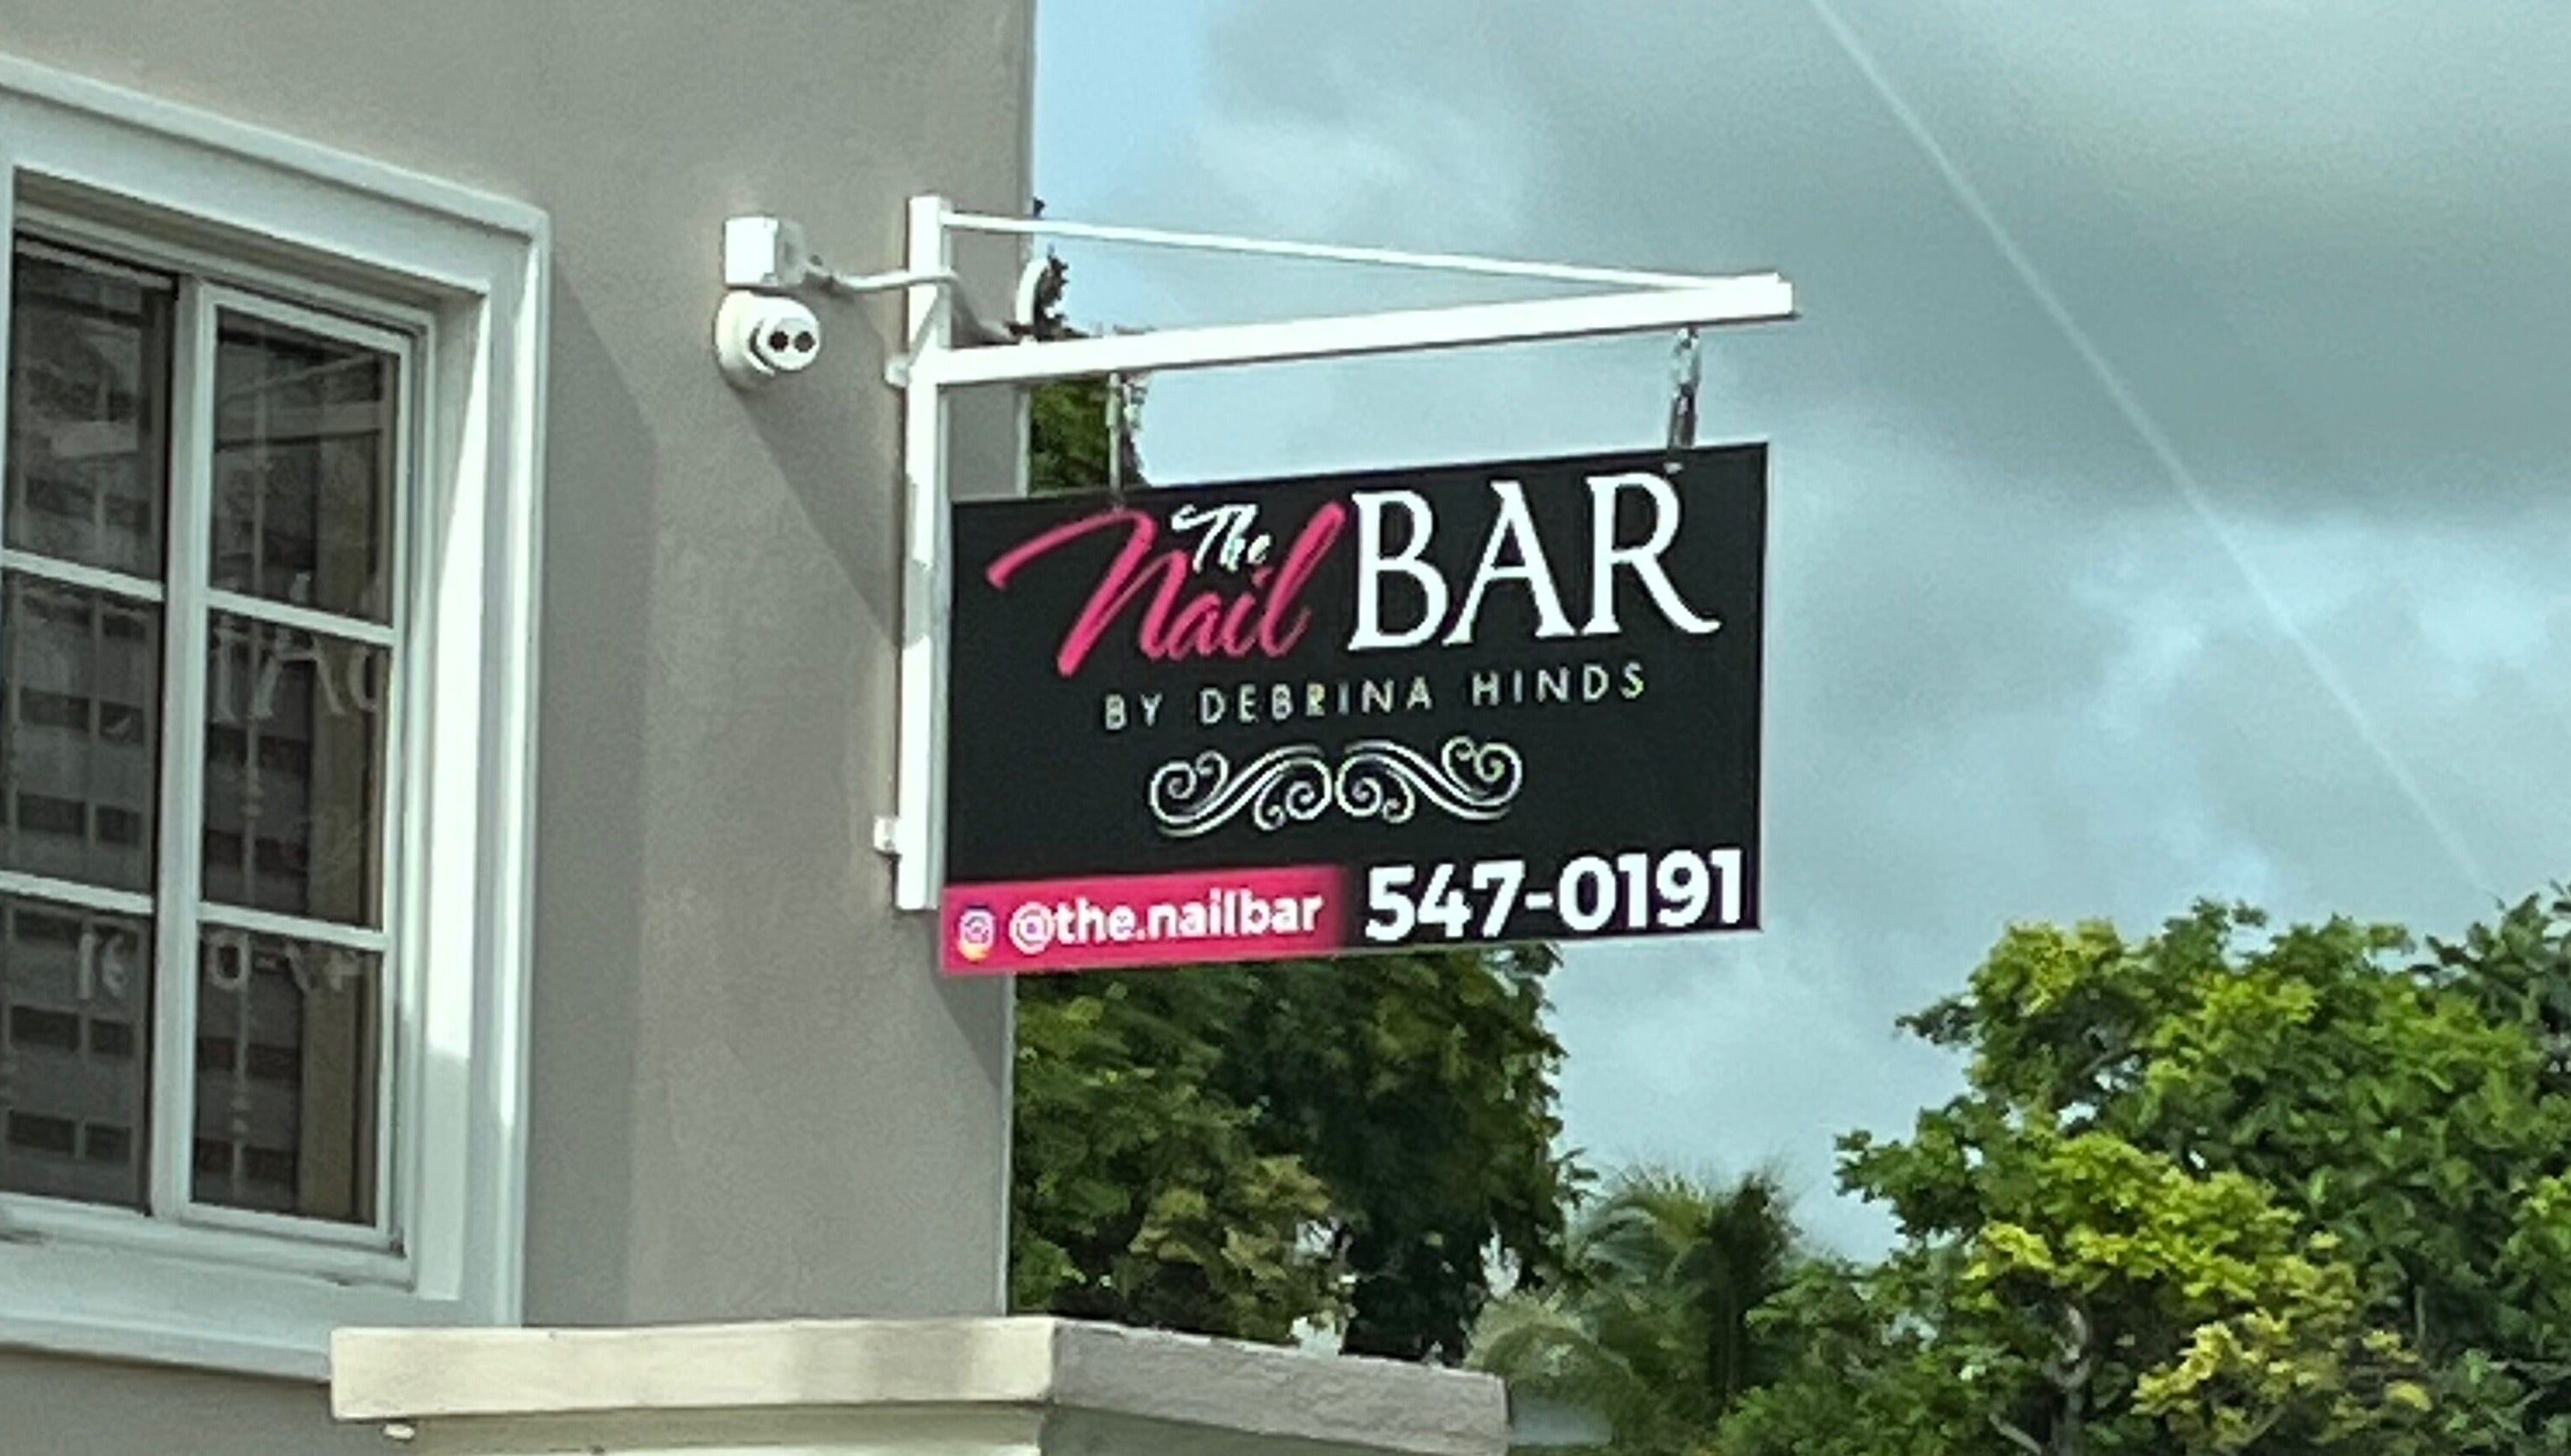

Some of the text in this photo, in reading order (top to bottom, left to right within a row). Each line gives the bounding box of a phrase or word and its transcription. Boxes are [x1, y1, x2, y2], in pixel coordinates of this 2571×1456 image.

[986, 474, 1721, 676] Nail BAR
[1171, 503, 1271, 573] The
[1104, 663, 1645, 730] BY DEBRINA HINDS
[1009, 849, 1743, 954] @the.nailbar 547-0191
